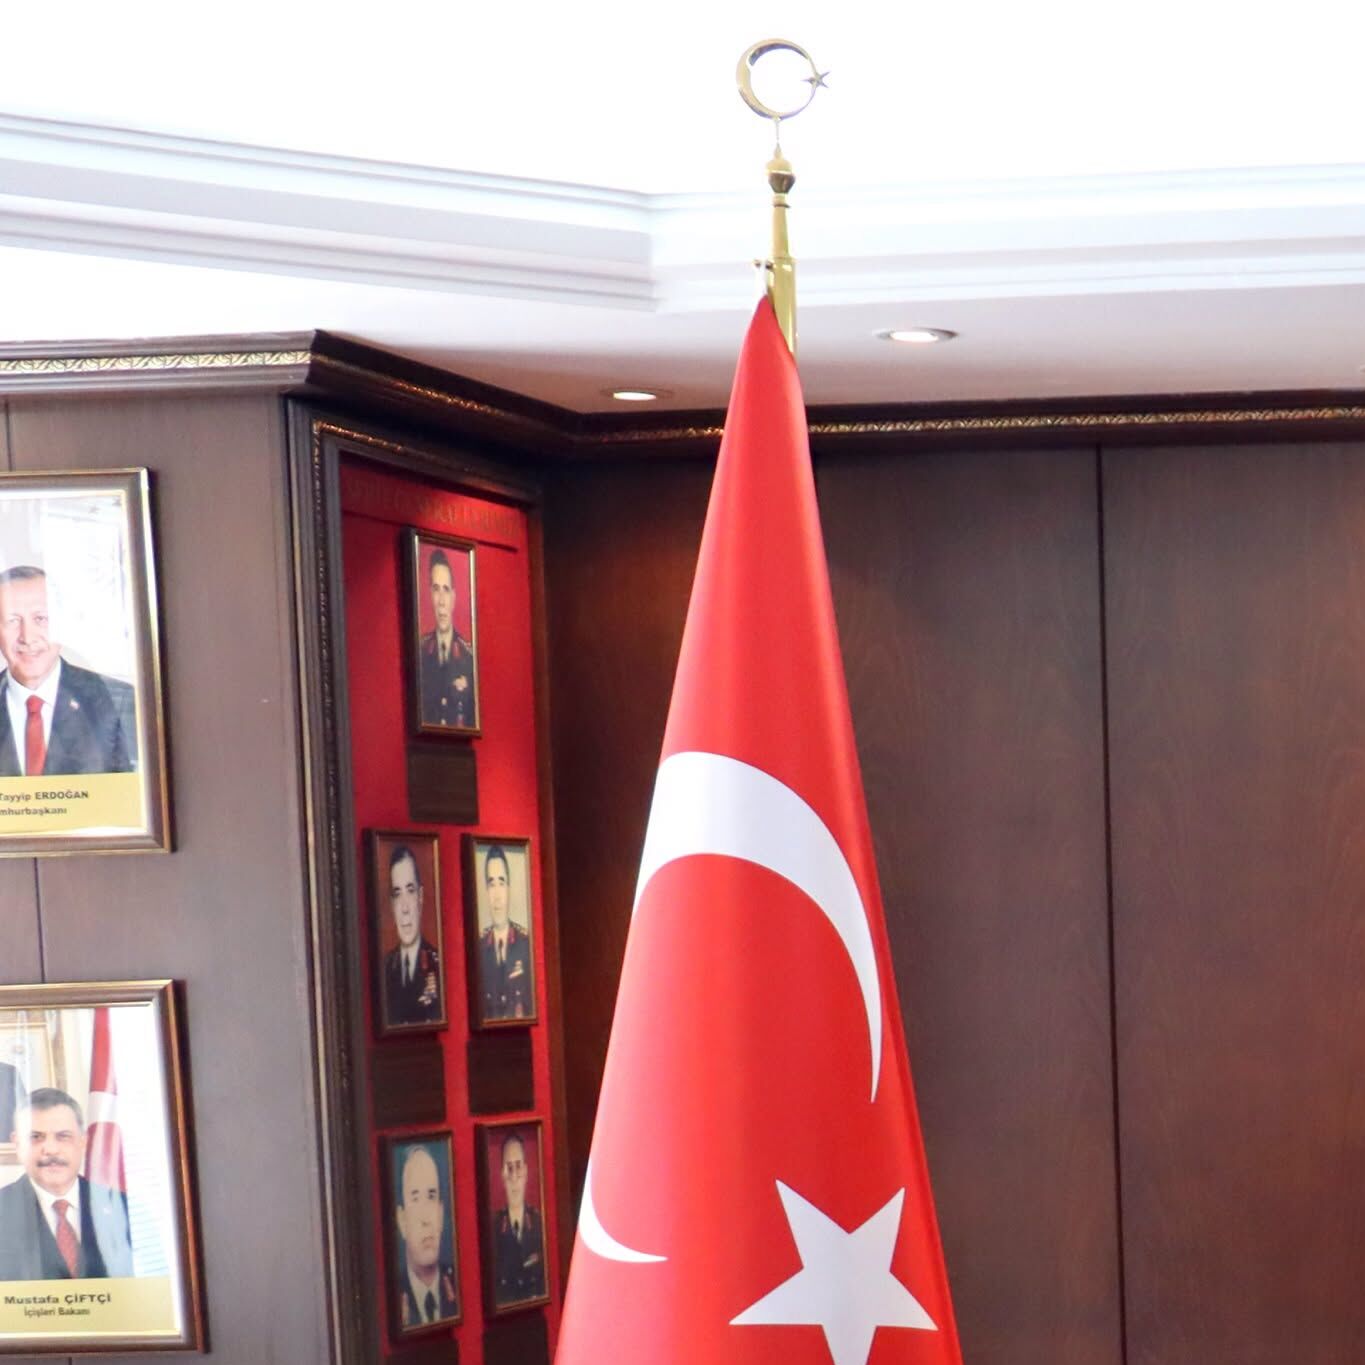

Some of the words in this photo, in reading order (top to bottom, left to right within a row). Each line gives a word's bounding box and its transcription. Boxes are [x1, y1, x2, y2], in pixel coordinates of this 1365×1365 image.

[35, 789, 89, 800] ERDOĞAN
[4, 1294, 59, 1304] Mustafa
[64, 1292, 112, 1305] ÇİFTÇİ
